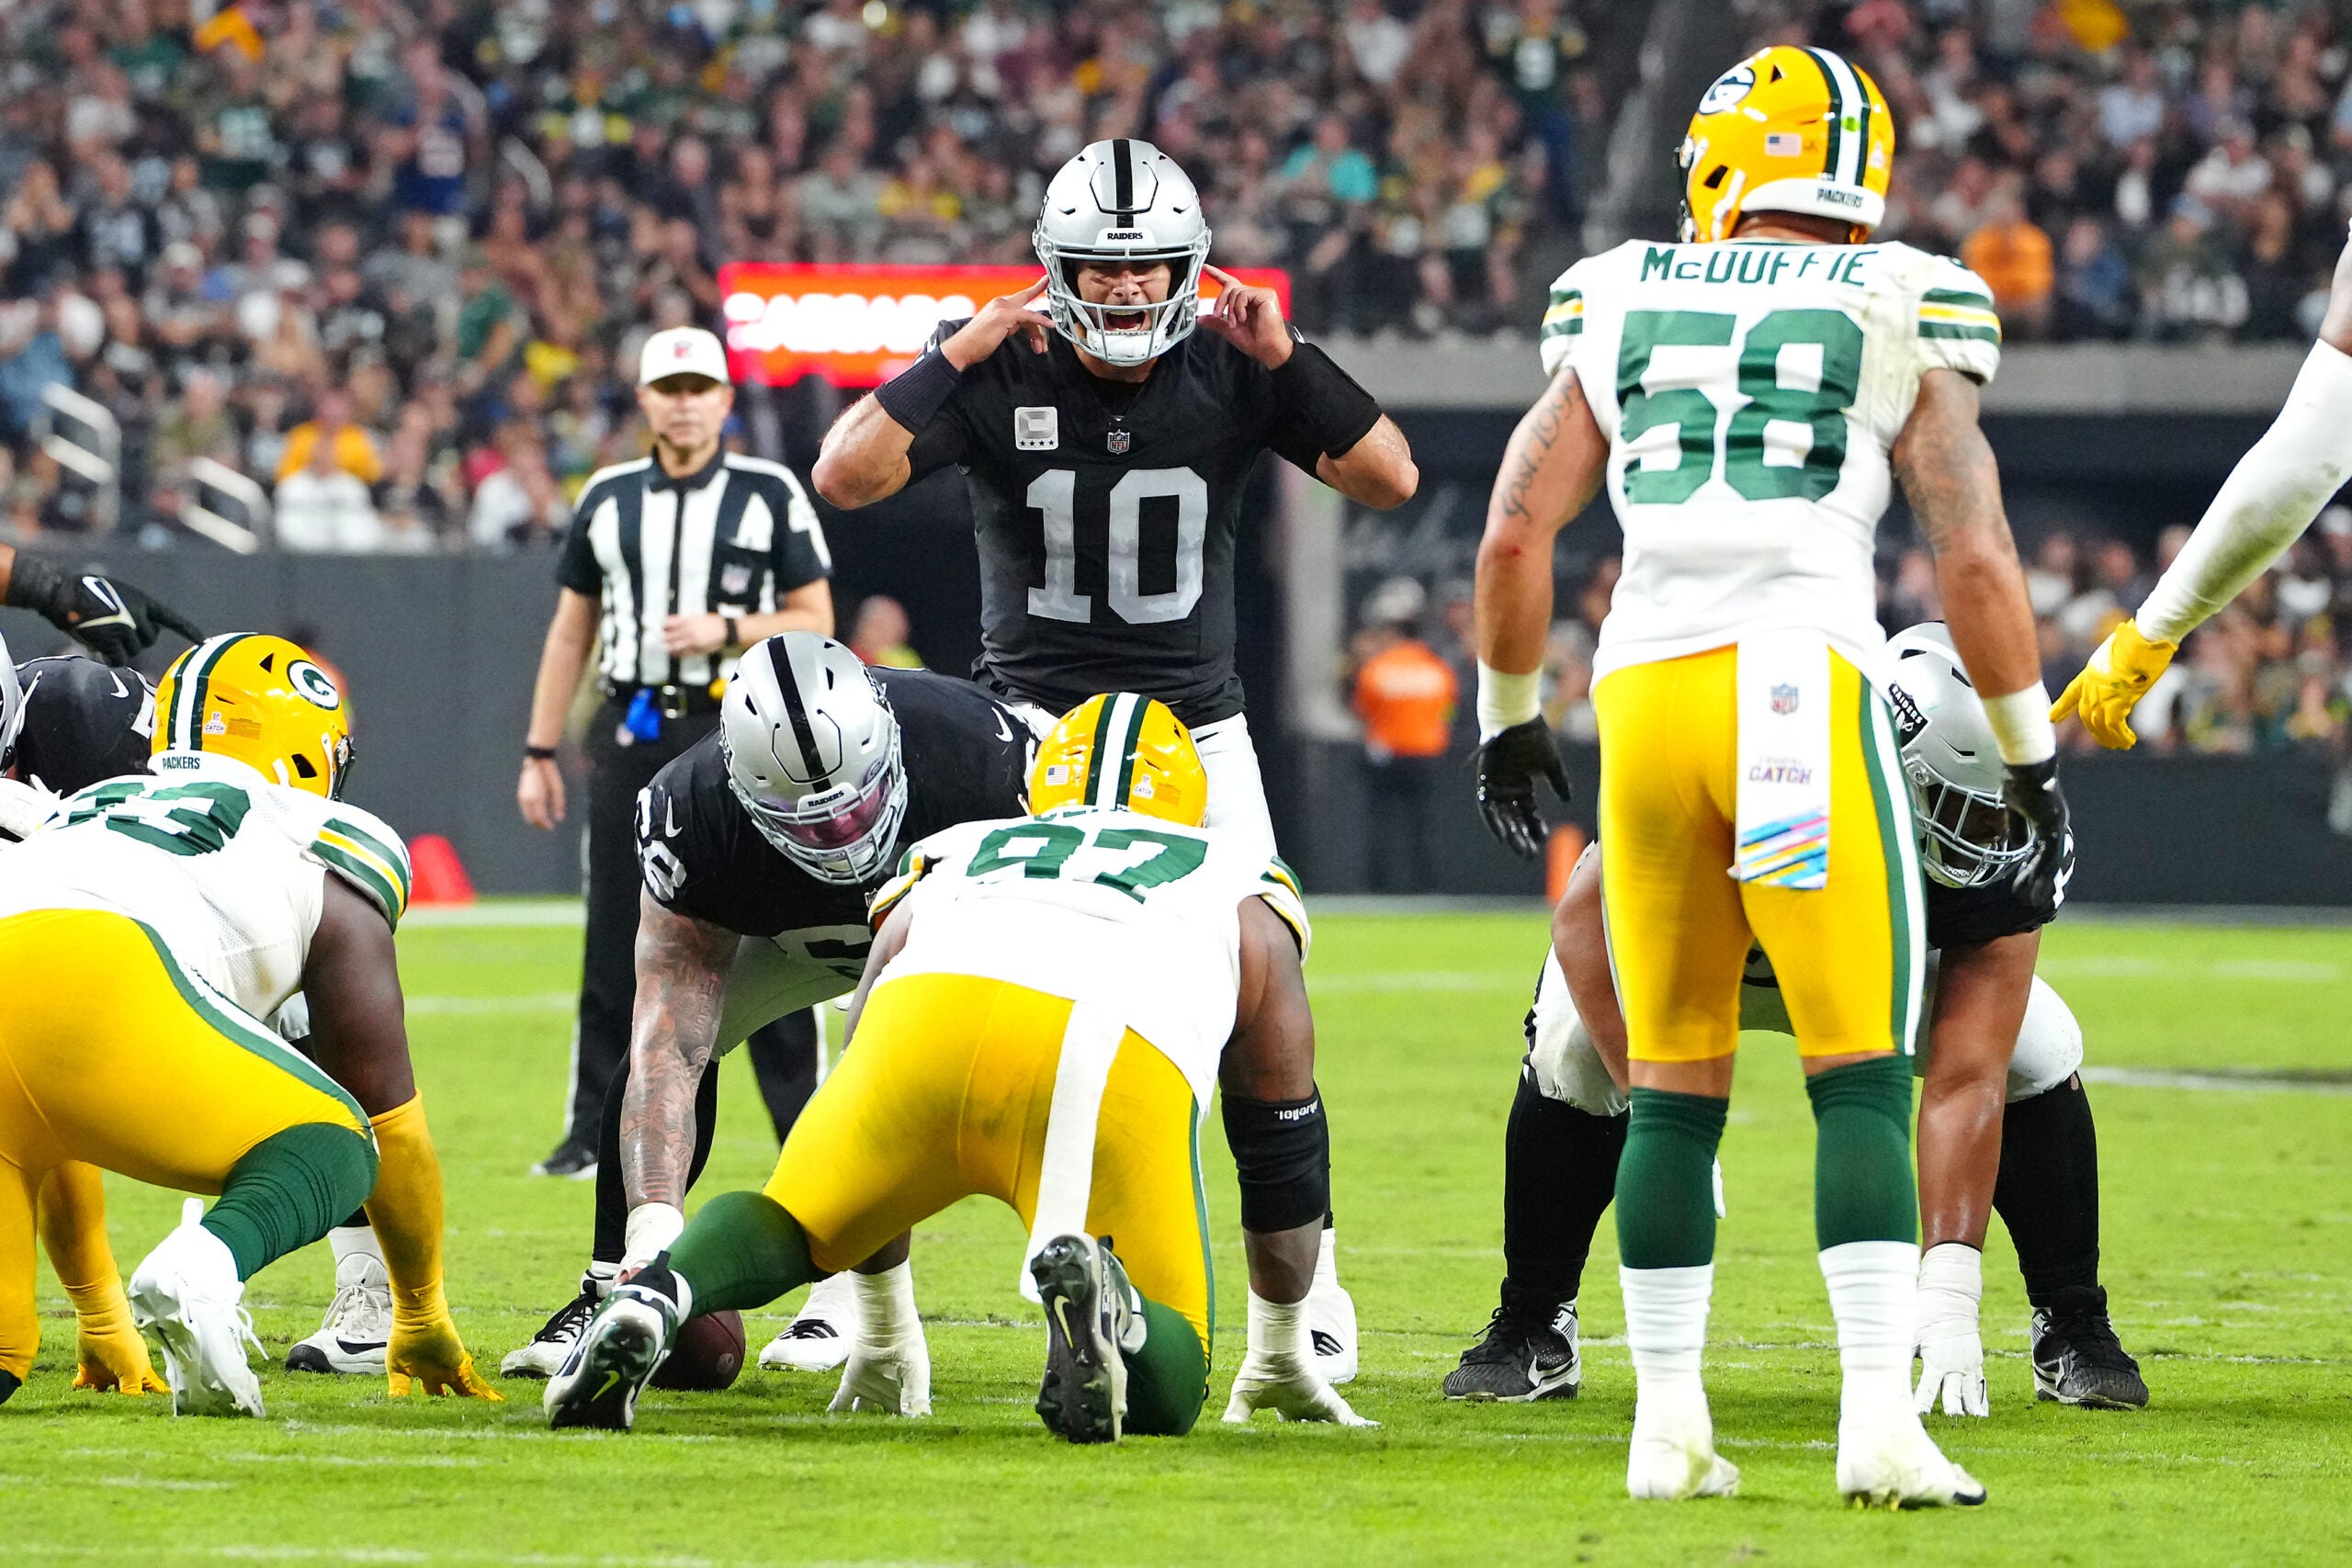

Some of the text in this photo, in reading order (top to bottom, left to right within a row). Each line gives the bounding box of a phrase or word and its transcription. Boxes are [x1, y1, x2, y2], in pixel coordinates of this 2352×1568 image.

[1107, 232, 1144, 241] RAIDERS
[1616, 310, 1864, 503] 58
[1026, 467, 1208, 625] 10
[1892, 684, 1923, 724] RAIDERS
[163, 756, 200, 770] PACKERS
[1749, 766, 1812, 784] CATCH
[808, 790, 844, 807] RAIDERS
[966, 823, 1208, 904] 97
